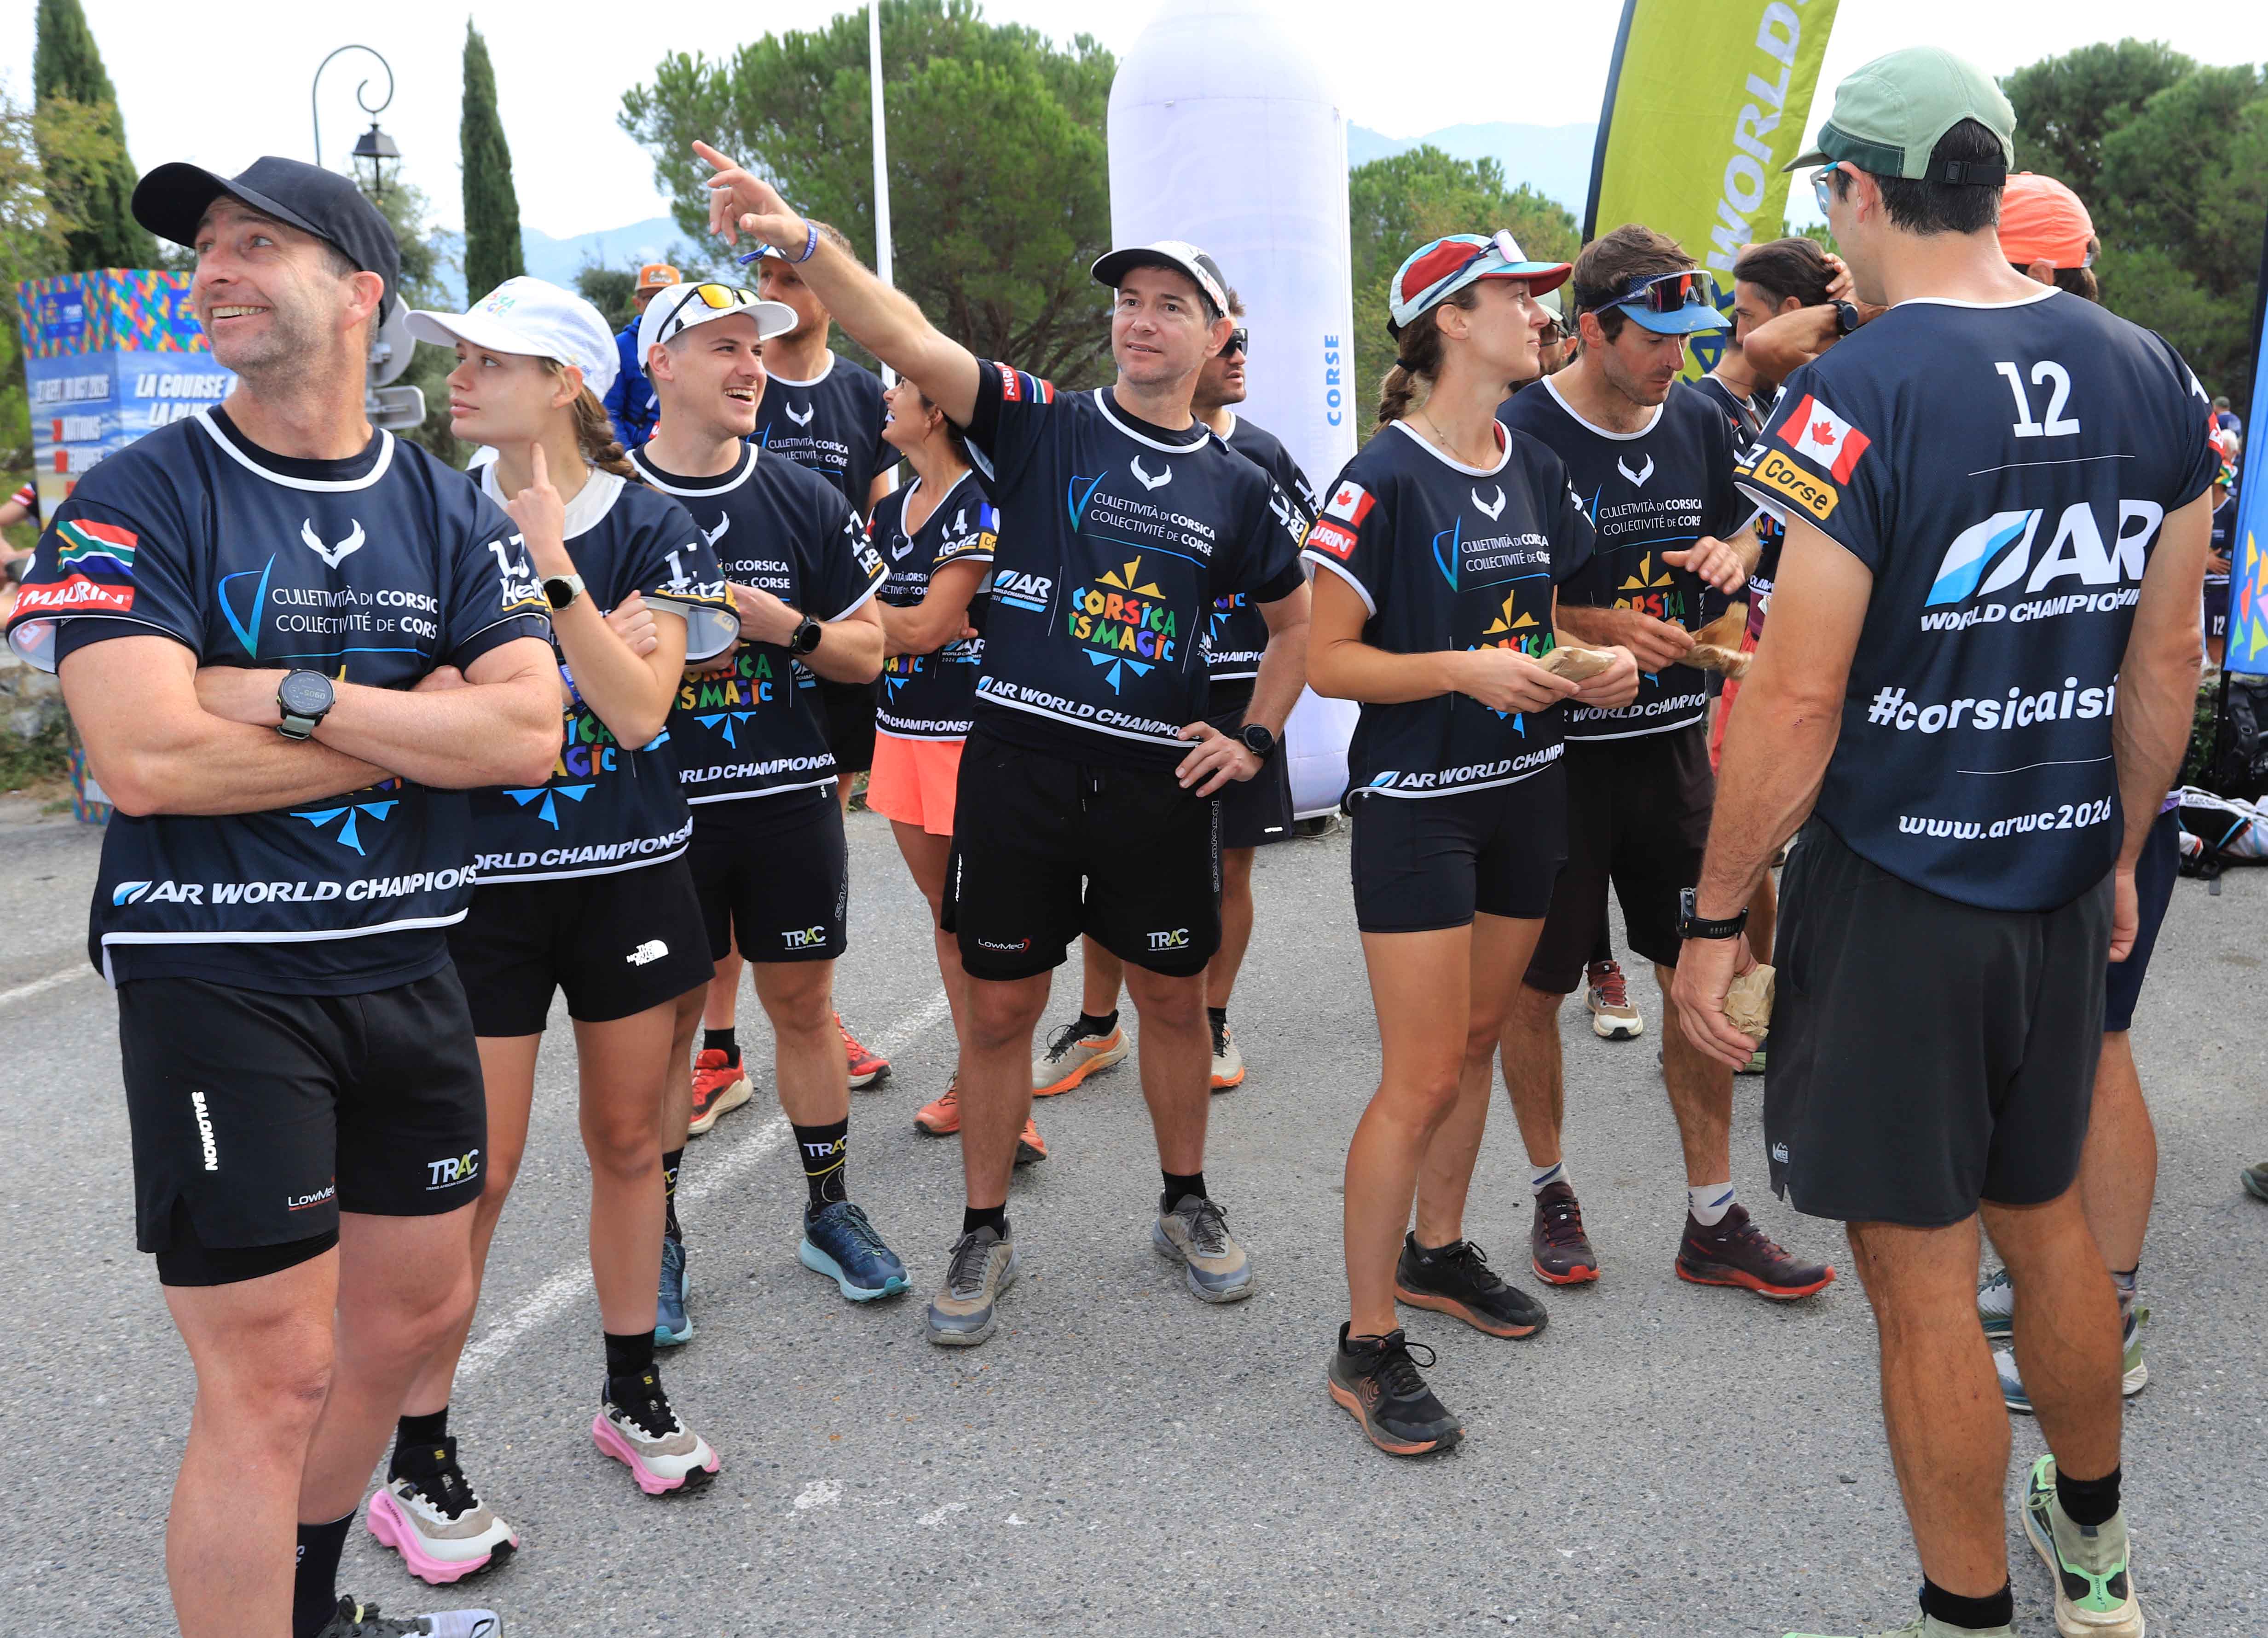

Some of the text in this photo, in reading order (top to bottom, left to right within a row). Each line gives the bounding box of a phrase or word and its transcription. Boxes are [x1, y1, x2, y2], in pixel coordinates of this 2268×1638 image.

[1707, 1, 1801, 272] WORLD
[135, 374, 157, 398] LA
[158, 375, 227, 398] COURSE
[1325, 335, 1342, 427] CORSE
[1995, 360, 2080, 438] 12
[149, 403, 170, 427] LA
[1764, 459, 1829, 512] Corse
[1094, 492, 1215, 541] CULLETTIVITÀ DI CORSICA
[1600, 499, 1702, 519] CULLETTIVITÀ DI CORSICA
[1667, 518, 1676, 527] DE
[1678, 515, 1701, 527] CORS
[1090, 509, 1212, 557] COLLECTIVITÉ DE CORSE
[2025, 498, 2164, 594] AR
[725, 559, 789, 573] DI CORSICA
[1465, 549, 1526, 572] COLLECTIVITÉ
[1527, 553, 1536, 563] DE
[23, 581, 125, 606] MAURIN
[750, 577, 791, 589] CORSE
[1011, 574, 1053, 598] AR
[272, 585, 358, 607] CULLETTIVITÀ
[360, 593, 373, 606] DI
[1007, 590, 1048, 604] CHAMPIONSHIP
[276, 611, 371, 634] COLLECTIVITÉ
[376, 618, 395, 632] DE
[1921, 603, 2007, 632] WORLD
[2212, 615, 2226, 635] 12
[989, 681, 1180, 737] AR WORLD CHAMPIO
[1573, 704, 1644, 722] WORLD
[679, 766, 723, 783] RLD
[1398, 771, 1437, 788] AR
[1439, 759, 1512, 784] WORLD
[1898, 795, 2111, 841] www.arwc2026
[145, 880, 205, 905] AR
[212, 881, 341, 904] WORLD
[781, 925, 826, 947] TRAC
[978, 938, 1024, 950] LowMed
[1146, 928, 1190, 948] TRAC
[191, 1091, 218, 1171] SALOMON
[427, 1148, 479, 1185] TRAC
